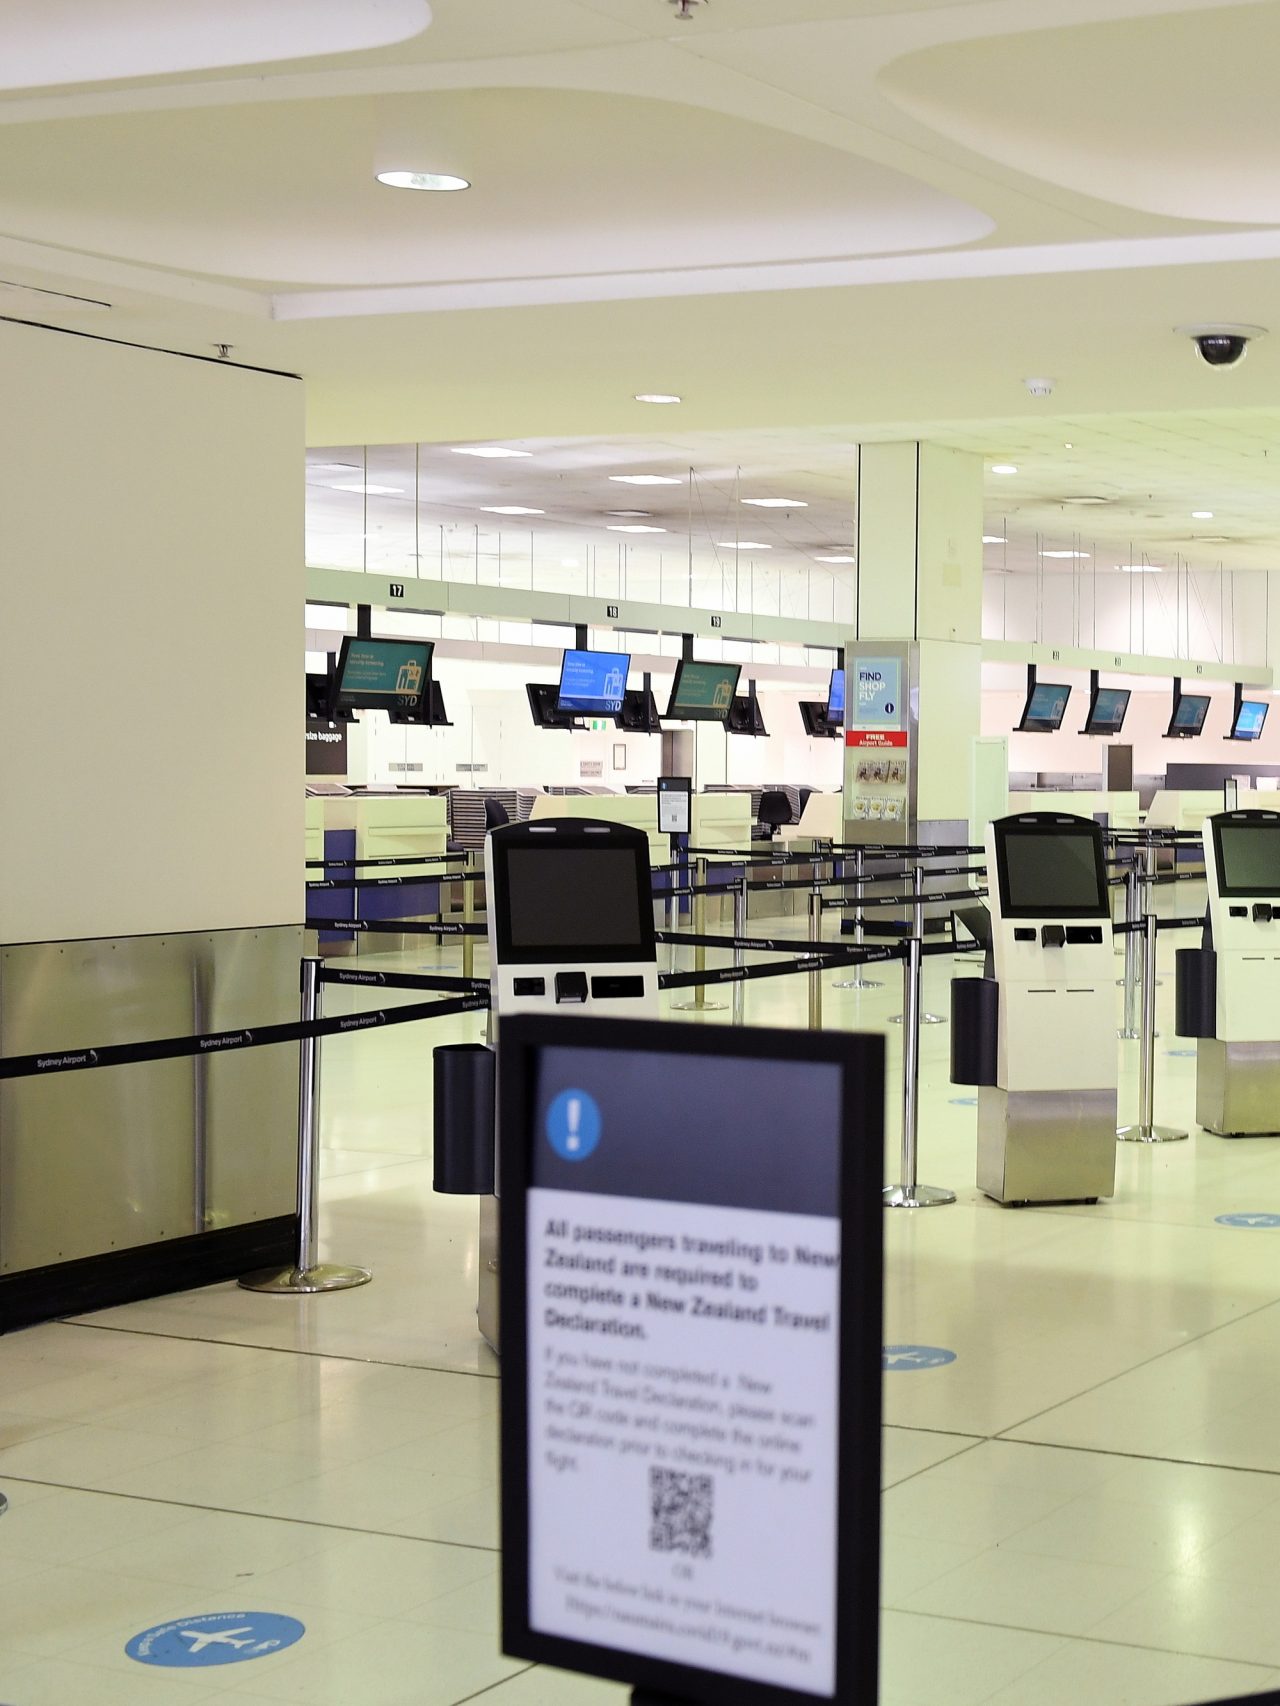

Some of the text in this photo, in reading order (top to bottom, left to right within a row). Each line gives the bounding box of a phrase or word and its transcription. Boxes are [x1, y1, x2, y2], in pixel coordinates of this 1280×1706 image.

[859, 672, 882, 681] FIND
[859, 681, 886, 690] SHOP
[397, 695, 418, 707] SYD
[859, 691, 876, 700] FLY
[605, 700, 622, 711] SYD
[318, 731, 342, 743] baggage
[866, 733, 885, 741] FREE
[340, 972, 377, 983] Sydney Airport
[340, 1016, 377, 1029] Sydney Airport
[200, 1034, 243, 1049] Sydney Airport
[37, 1054, 87, 1068] Sydney Airport
[545, 1220, 568, 1238] All
[573, 1224, 676, 1251] passengers
[768, 1243, 787, 1263] to
[794, 1246, 840, 1268] New
[544, 1248, 758, 1292] Zealand are required to
[544, 1283, 831, 1332] complete a New Zealand Travel
[544, 1308, 646, 1339] Declaration.
[544, 1371, 596, 1395] Zealand
[601, 1379, 637, 1399] Travel
